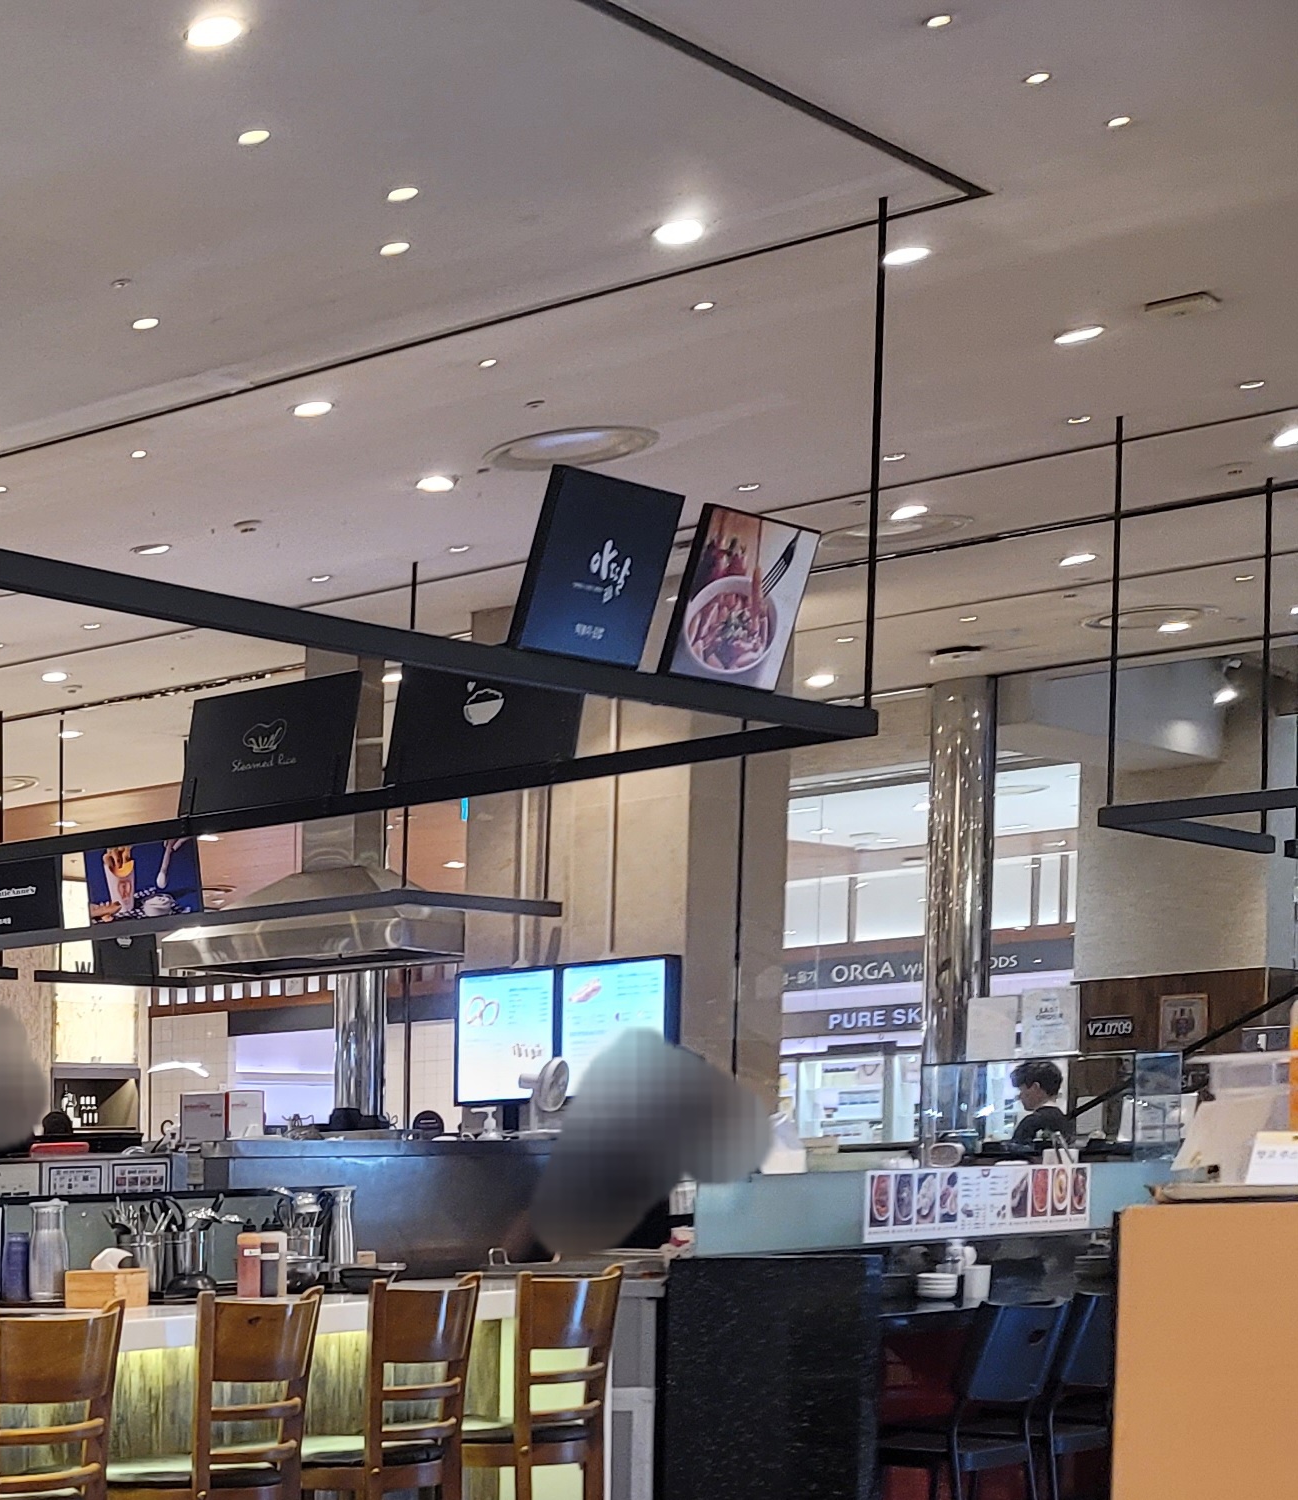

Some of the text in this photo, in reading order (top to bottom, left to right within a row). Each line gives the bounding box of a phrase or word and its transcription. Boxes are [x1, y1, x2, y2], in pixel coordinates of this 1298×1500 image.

[231, 754, 274, 773] Steamed
[831, 961, 896, 984] ORGA
[828, 1009, 887, 1030] PURE
[1087, 1021, 1133, 1037] V2.0709
